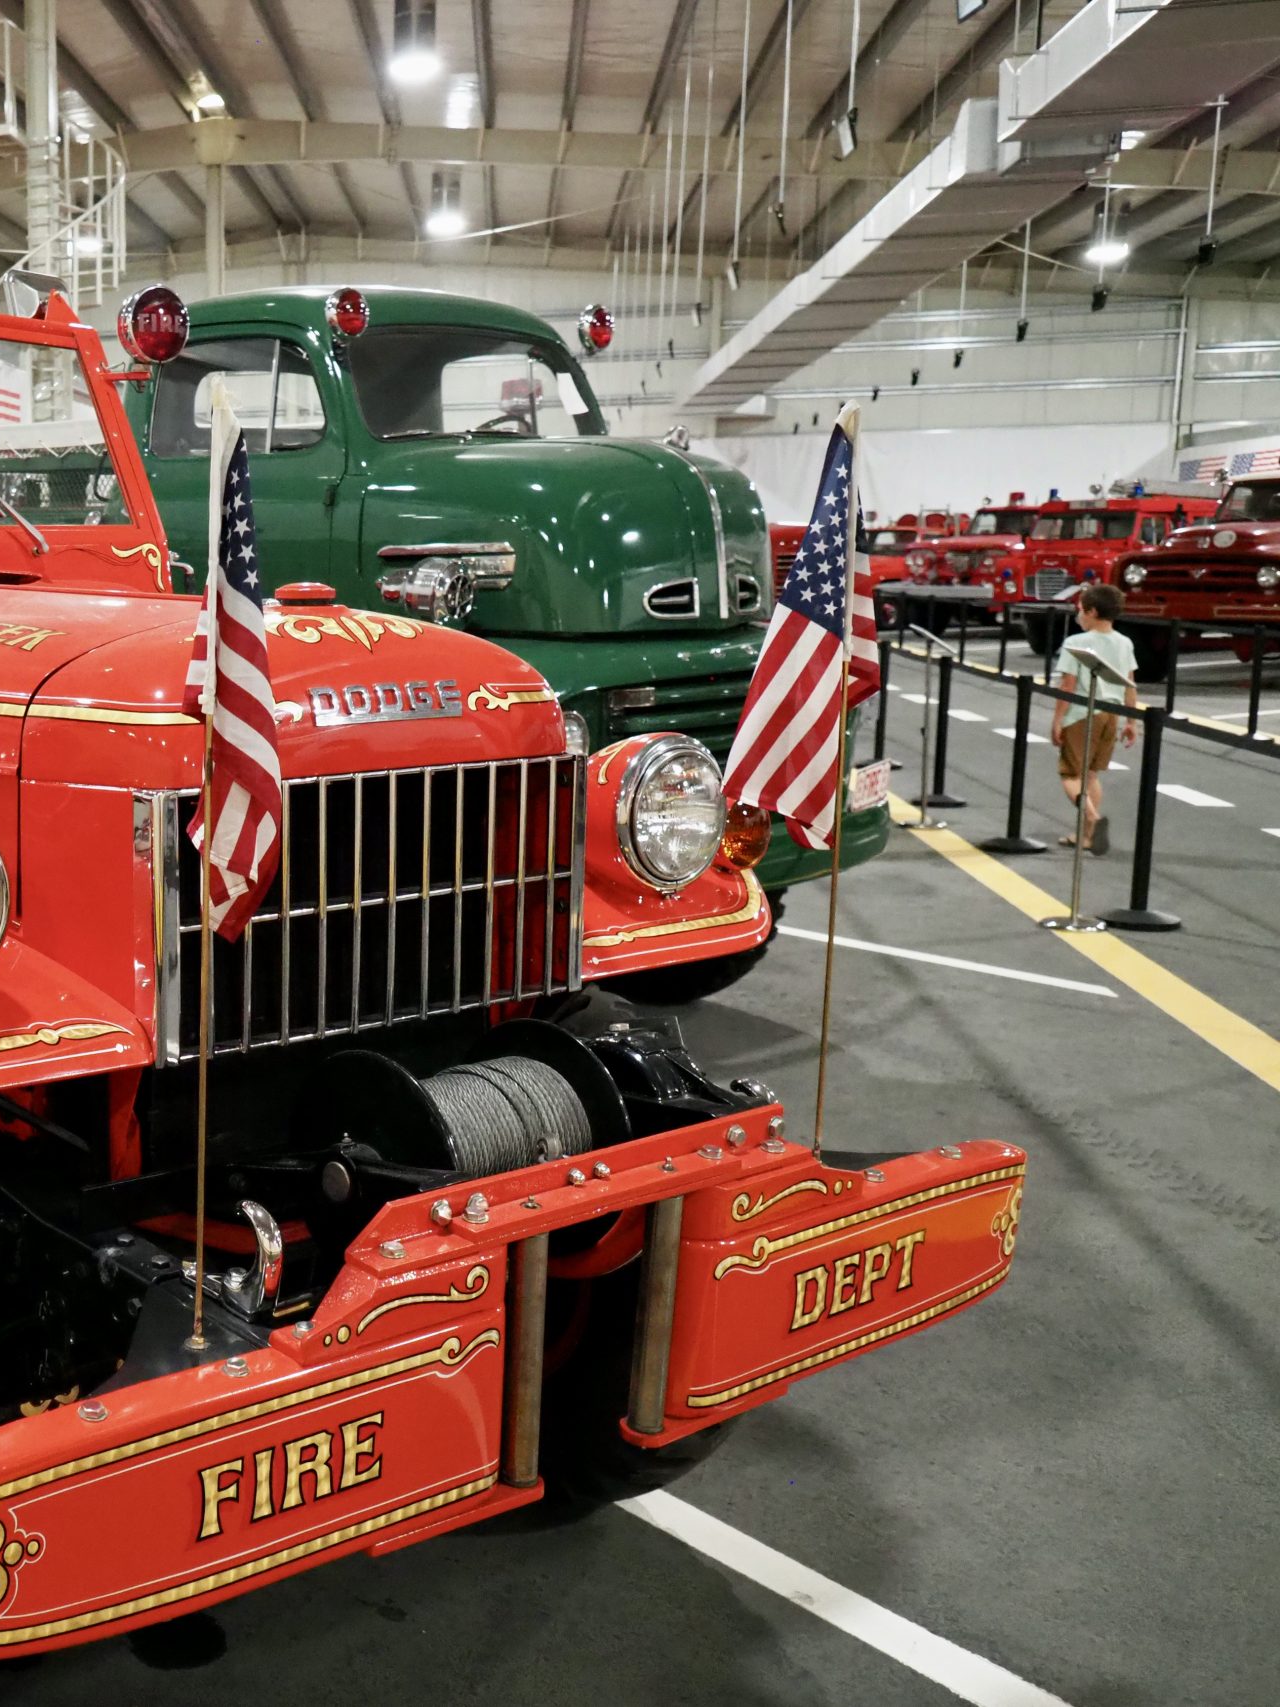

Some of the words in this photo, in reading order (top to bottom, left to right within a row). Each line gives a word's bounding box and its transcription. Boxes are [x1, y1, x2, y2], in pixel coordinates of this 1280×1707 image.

[137, 312, 185, 333] FIRE
[307, 679, 462, 719] DODGE
[788, 1228, 927, 1334] DEPT
[196, 1410, 384, 1543] FIRE
